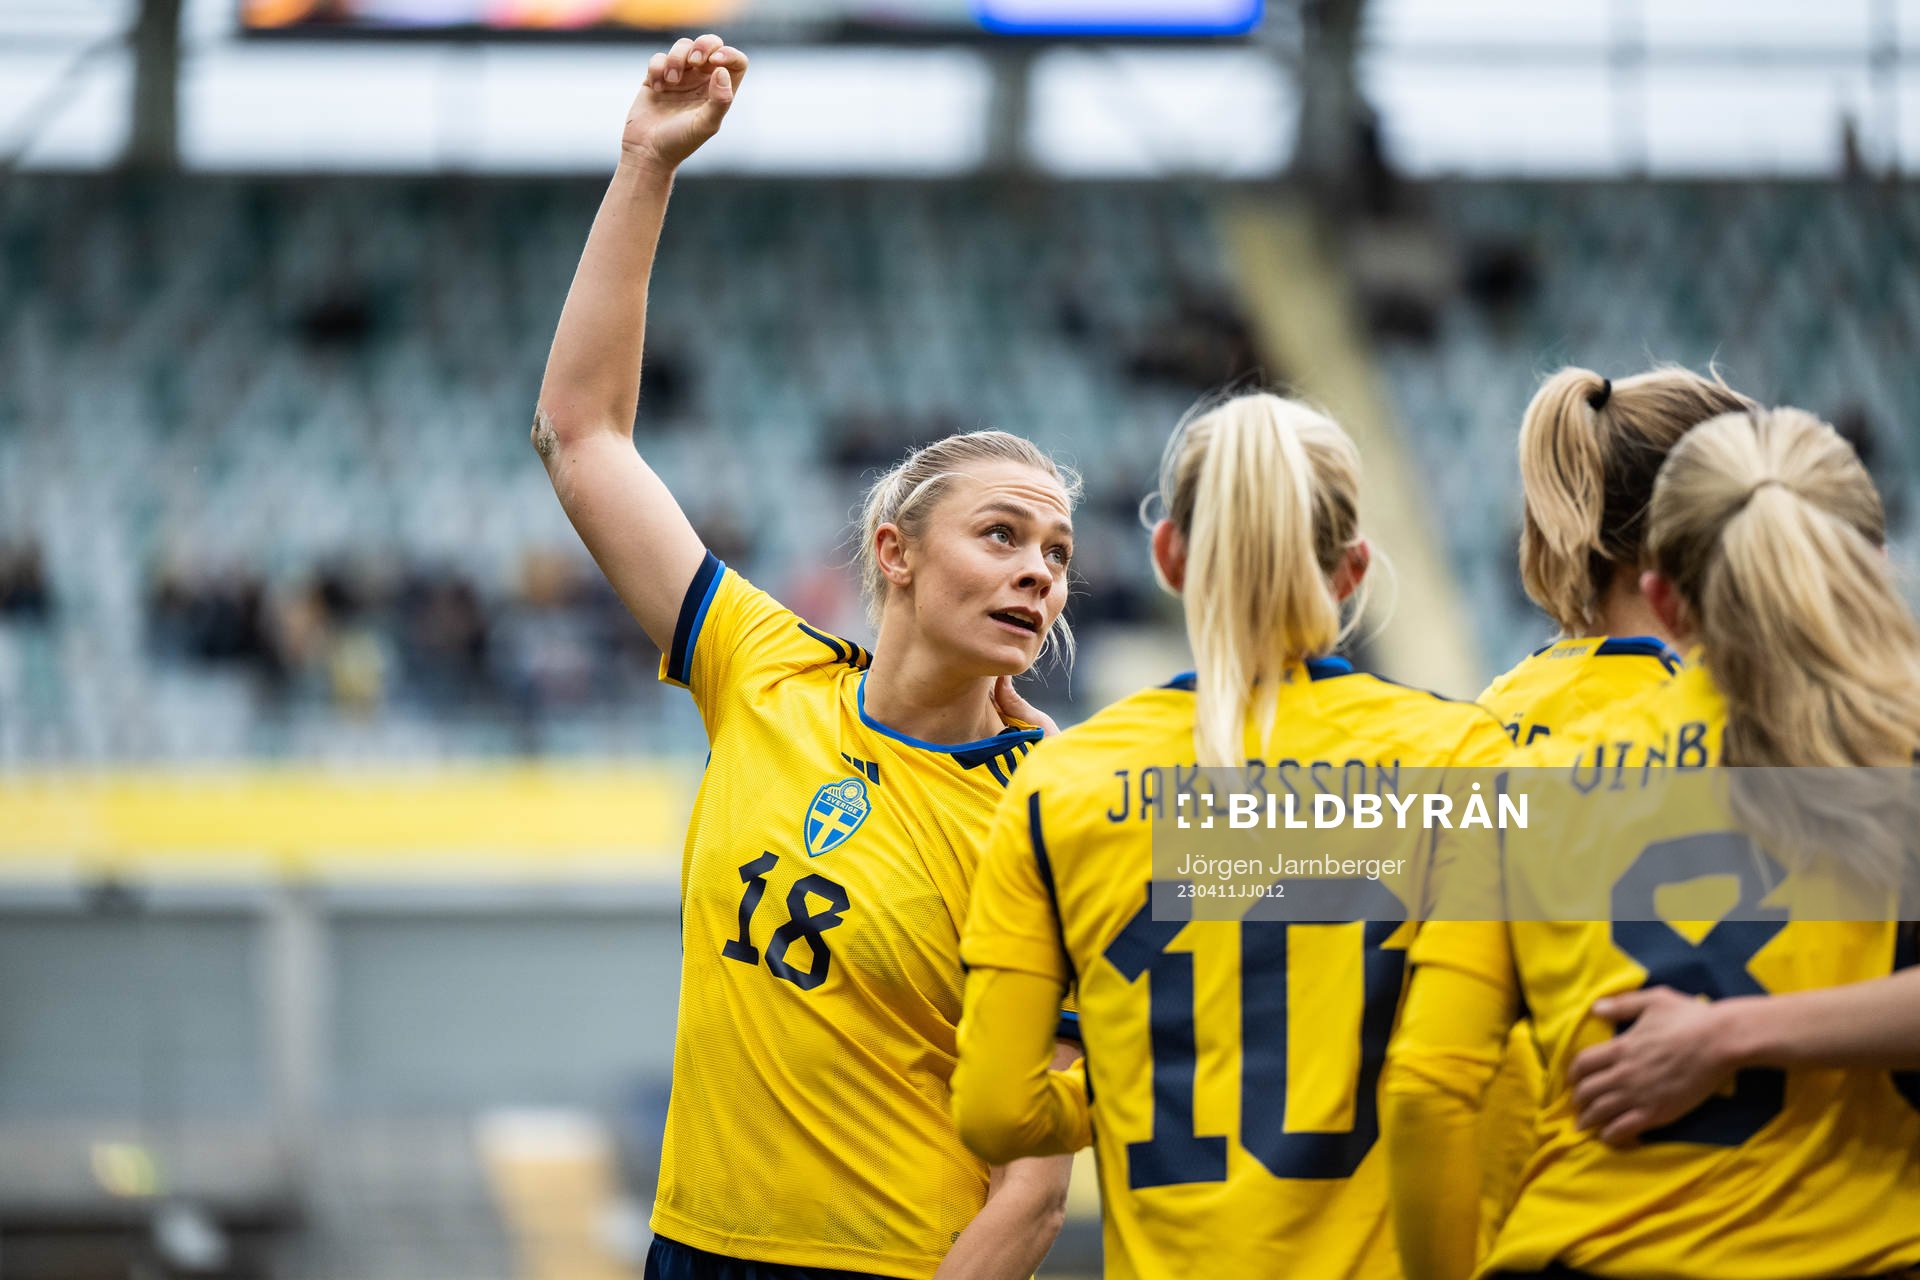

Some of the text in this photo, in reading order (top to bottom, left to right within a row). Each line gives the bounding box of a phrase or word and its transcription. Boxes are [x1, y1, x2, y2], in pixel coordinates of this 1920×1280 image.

[826, 795, 859, 814] SVERIGE
[722, 850, 851, 991] 18
[1104, 877, 1407, 1190] 10
[1610, 832, 1790, 1146] 8
